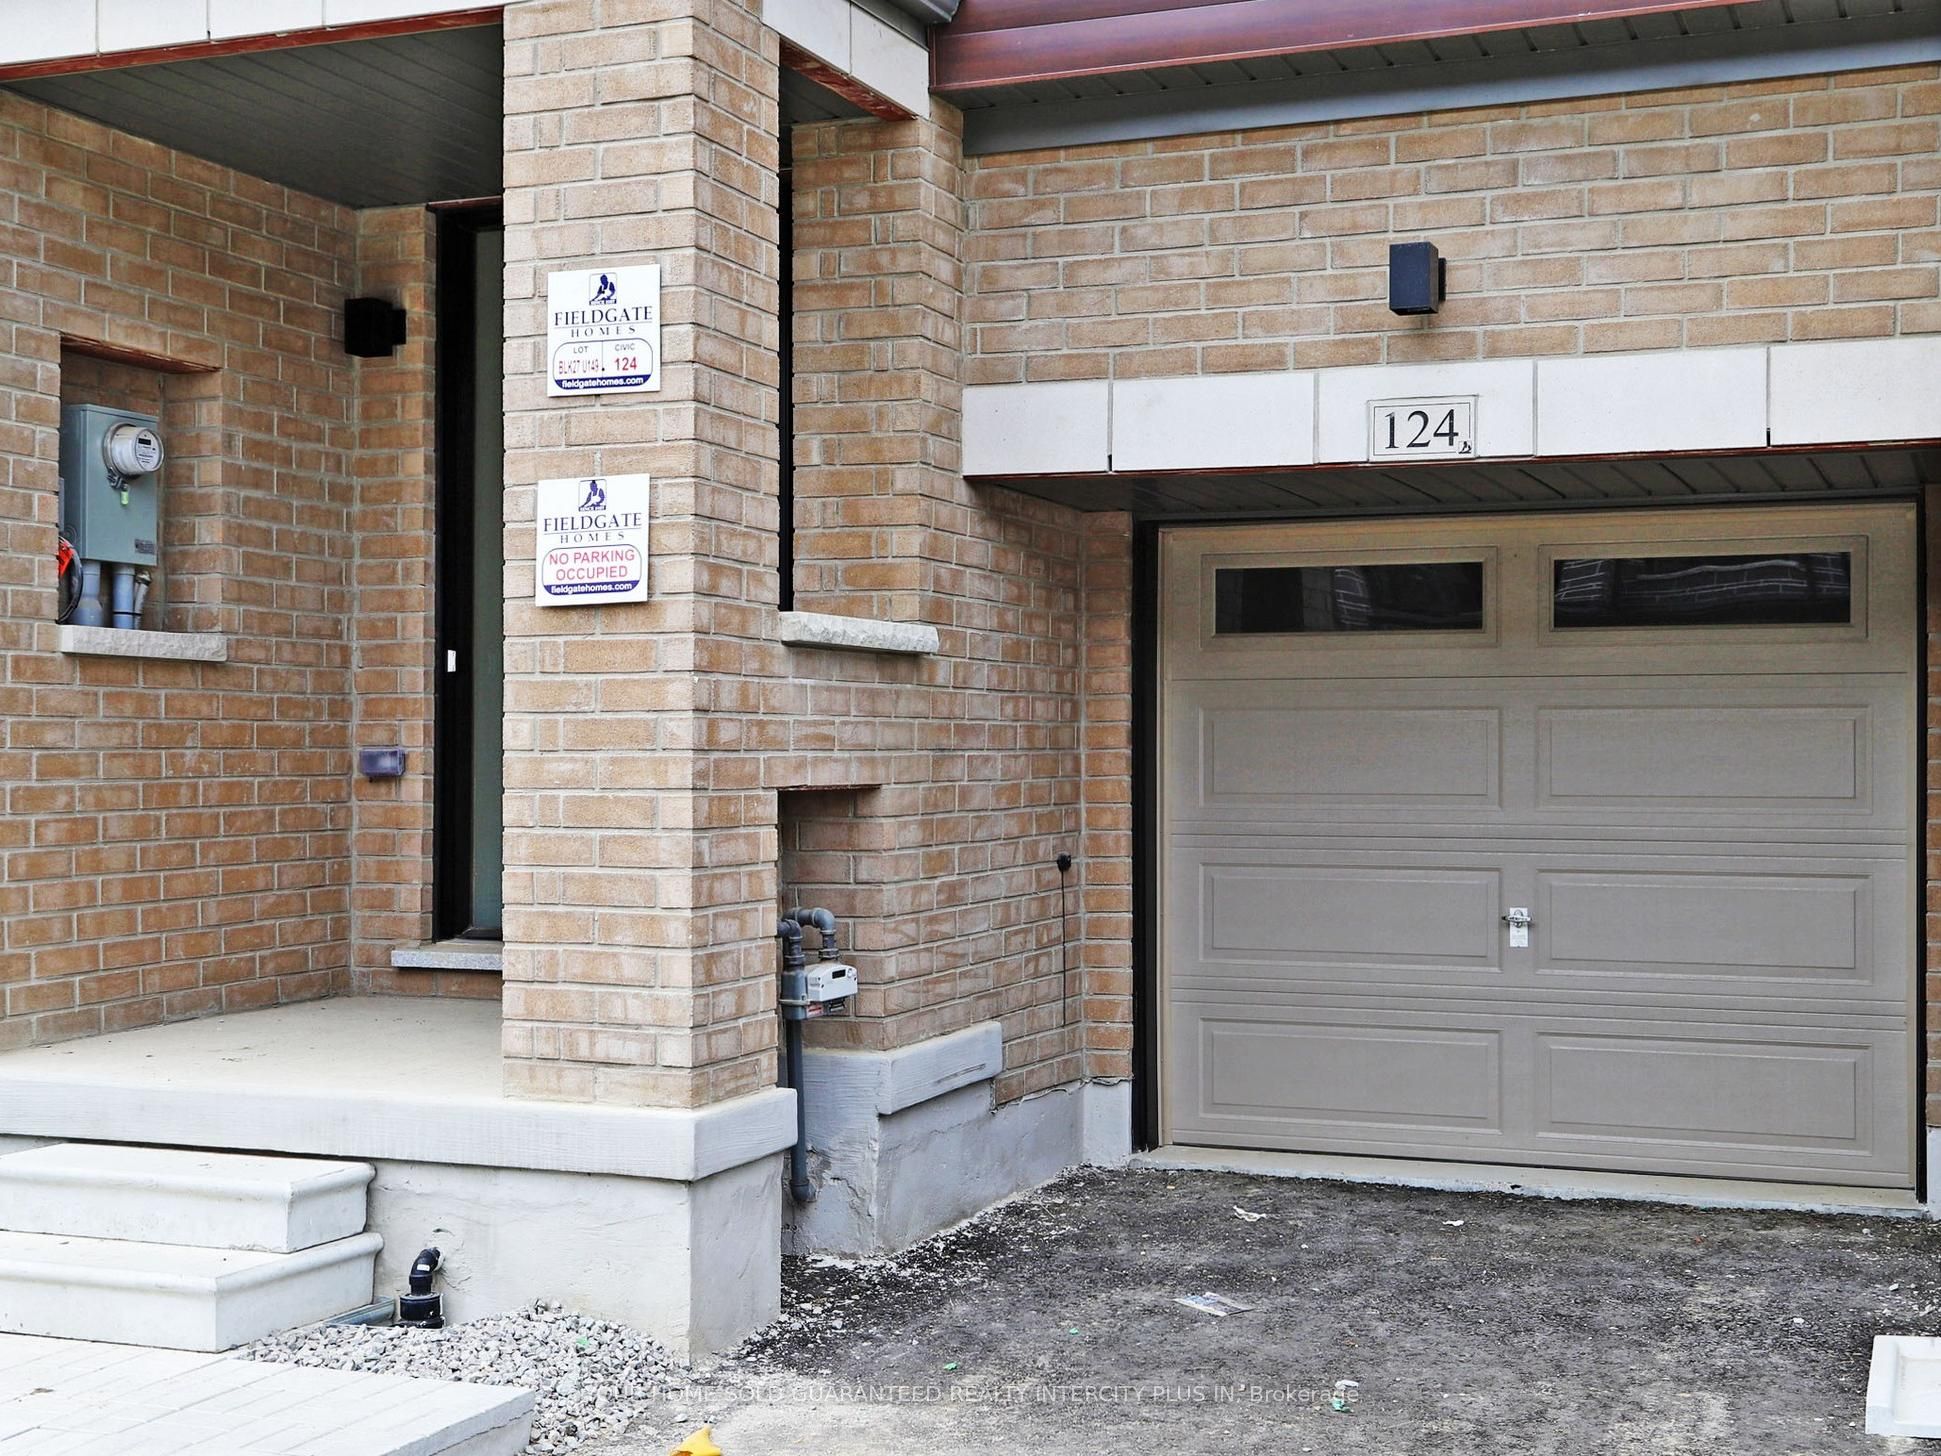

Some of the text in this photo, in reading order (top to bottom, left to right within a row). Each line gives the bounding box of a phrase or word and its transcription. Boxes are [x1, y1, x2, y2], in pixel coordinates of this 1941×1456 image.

[554, 306, 653, 326] FIELDGATE
[571, 325, 636, 338] HOMES
[573, 345, 588, 354] LOT
[614, 343, 635, 352] CIVIC
[614, 356, 637, 371] 124
[562, 376, 644, 389] fieldgatehomes.com
[1385, 409, 1459, 449] 124
[543, 512, 642, 532] FIELDGATE
[560, 531, 625, 544] HOMES
[549, 549, 635, 565] NO PARKING
[556, 565, 628, 581] OCCUPIED
[551, 582, 633, 595] fieldgatehomes.com
